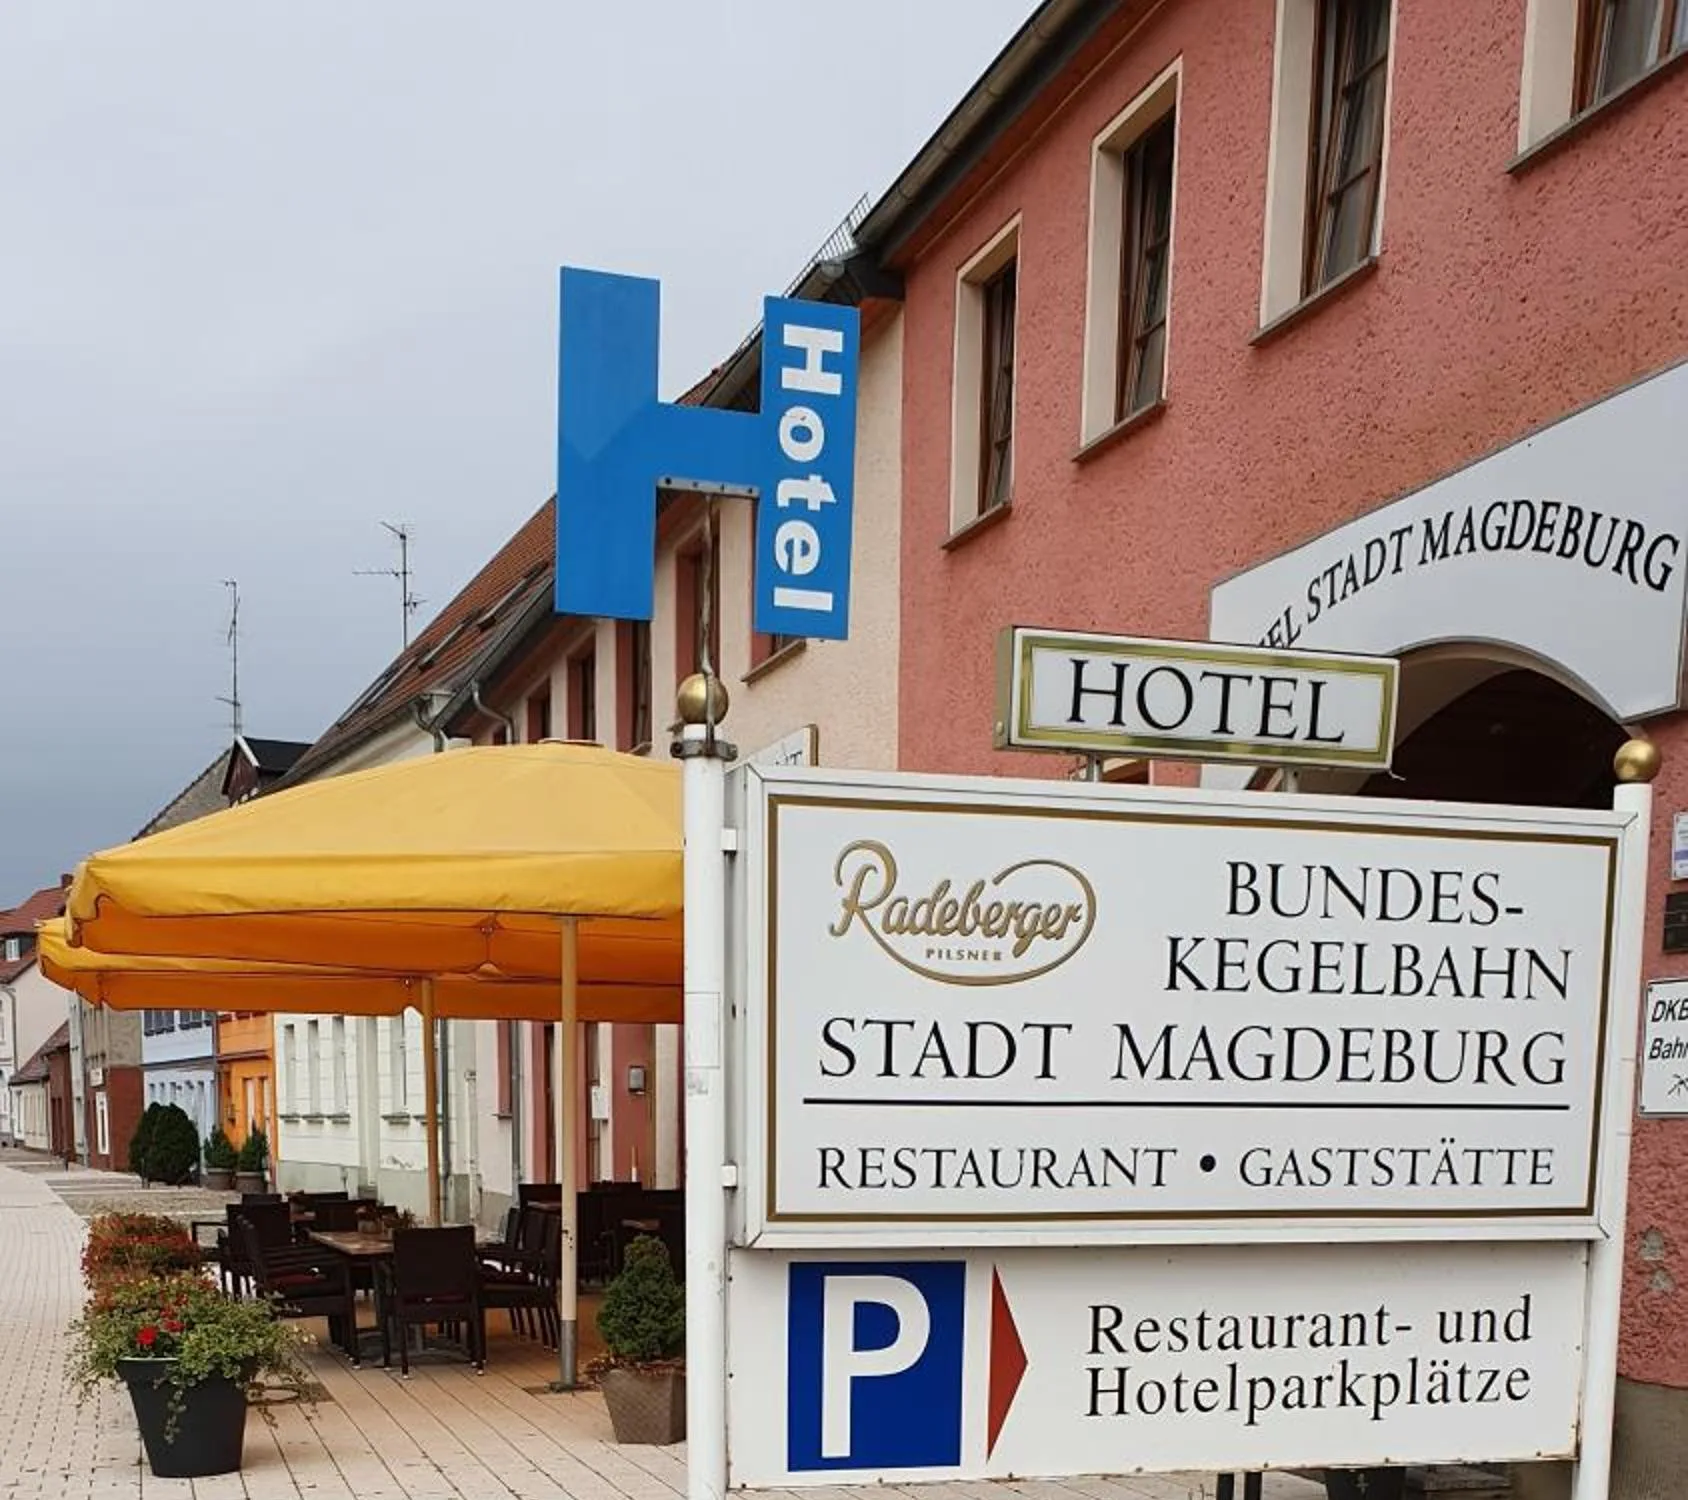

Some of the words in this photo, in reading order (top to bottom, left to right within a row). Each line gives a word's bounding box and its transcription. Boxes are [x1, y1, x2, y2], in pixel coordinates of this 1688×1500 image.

[773, 324, 844, 612] Hotel
[1306, 525, 1413, 624] STADT
[1418, 499, 1680, 592] MAGDEBURG
[1066, 658, 1345, 743] HOTEL
[829, 839, 1097, 987] Radeberger
[1226, 860, 1524, 926] BUNDES-
[925, 949, 1002, 961] PILSNER
[1163, 936, 1573, 1000] KEGELBAHN
[818, 1016, 1073, 1080] STADT
[1110, 1023, 1566, 1087] MAGDEBURG
[816, 1146, 1179, 1190] RESTAURANT
[1239, 1137, 1555, 1188] GASTSTÄTTE
[1087, 1303, 1413, 1355] Restaurant-
[1437, 1293, 1533, 1344] und
[821, 1275, 931, 1459] P
[1085, 1357, 1532, 1427] Hotelparkplätze
